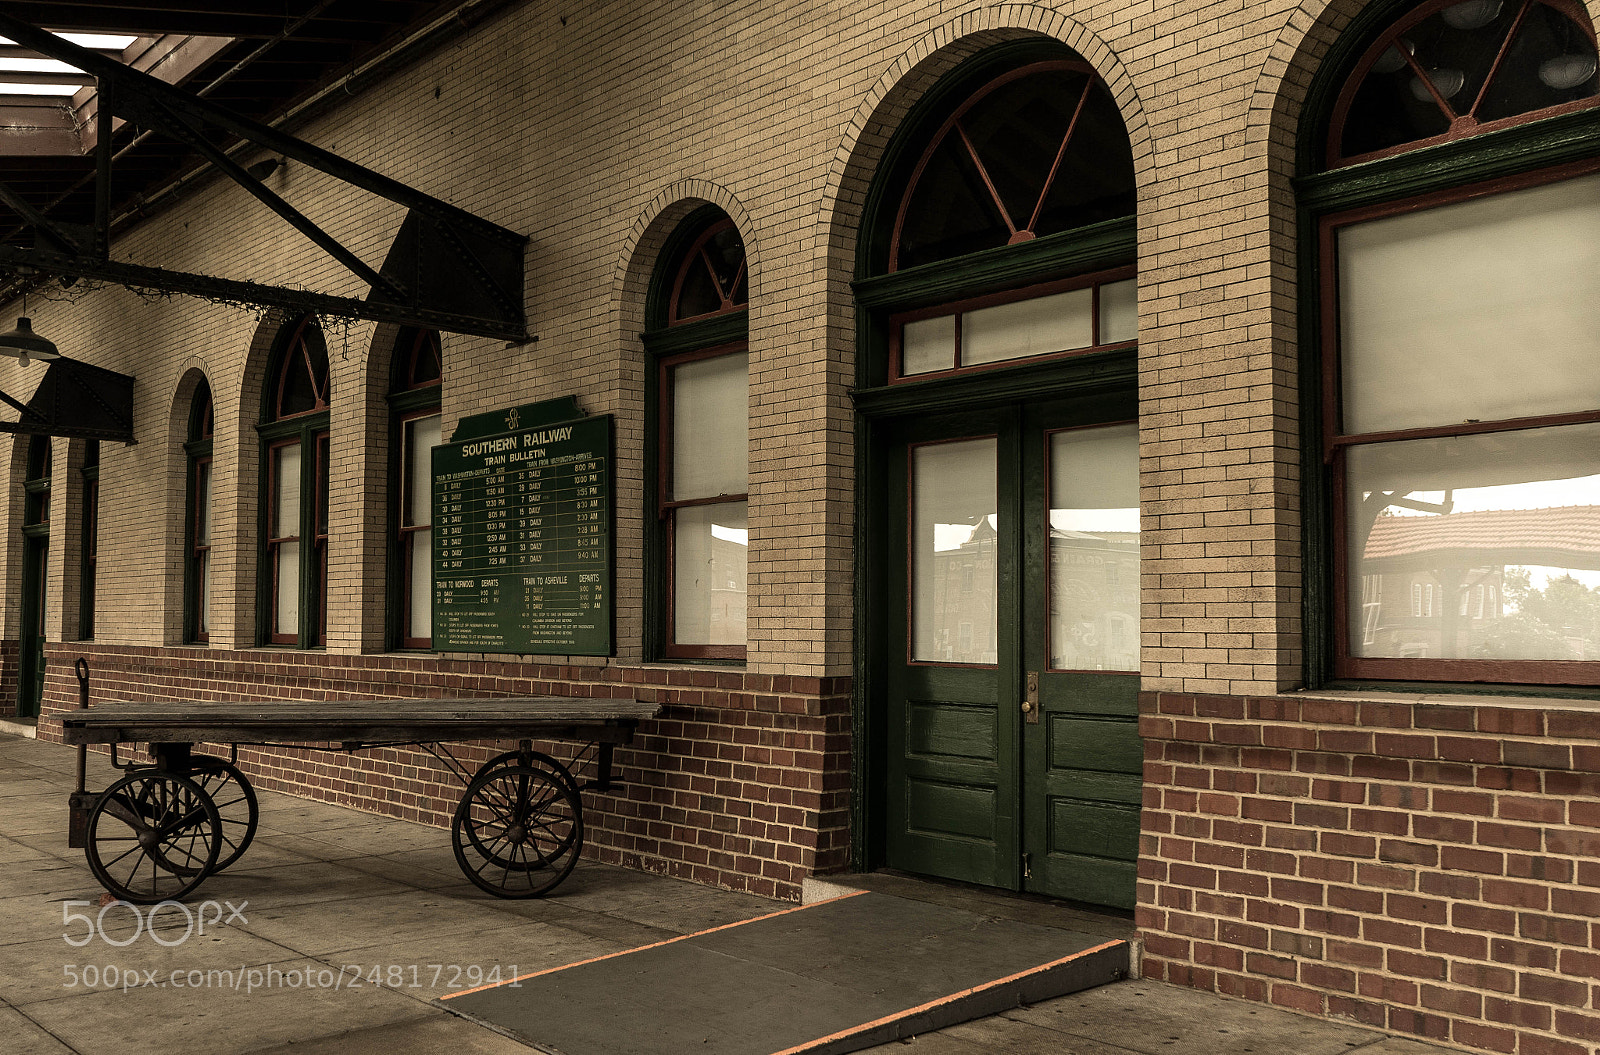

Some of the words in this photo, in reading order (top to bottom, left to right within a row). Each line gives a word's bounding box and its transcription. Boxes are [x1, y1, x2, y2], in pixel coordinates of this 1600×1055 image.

[462, 436, 517, 458] SOUTHERN
[524, 426, 573, 448] RAILWAY
[484, 455, 506, 466] TRAIN
[510, 448, 546, 462] BULLETIN
[526, 460, 538, 468] TRAIN
[538, 458, 549, 467] FROM
[529, 470, 541, 478] DAILY
[588, 462, 596, 470] PM
[451, 482, 461, 490] DAILY
[529, 482, 541, 490] DAILY
[589, 474, 597, 482] PM
[529, 494, 541, 502] DAILY
[590, 487, 597, 495] PM
[590, 500, 598, 508] AM
[530, 518, 542, 526] DAILY
[590, 512, 598, 520] AM
[529, 530, 541, 538] DAILY
[590, 525, 598, 533] AM
[499, 545, 507, 553] AM
[451, 560, 463, 568] DAILY
[530, 555, 542, 563] DAILY
[481, 579, 499, 587] DEPARTS
[523, 578, 536, 586] TRAIN
[537, 577, 543, 585] TO
[544, 576, 568, 585] ASHEVILLE
[579, 574, 600, 583] DEPARTS
